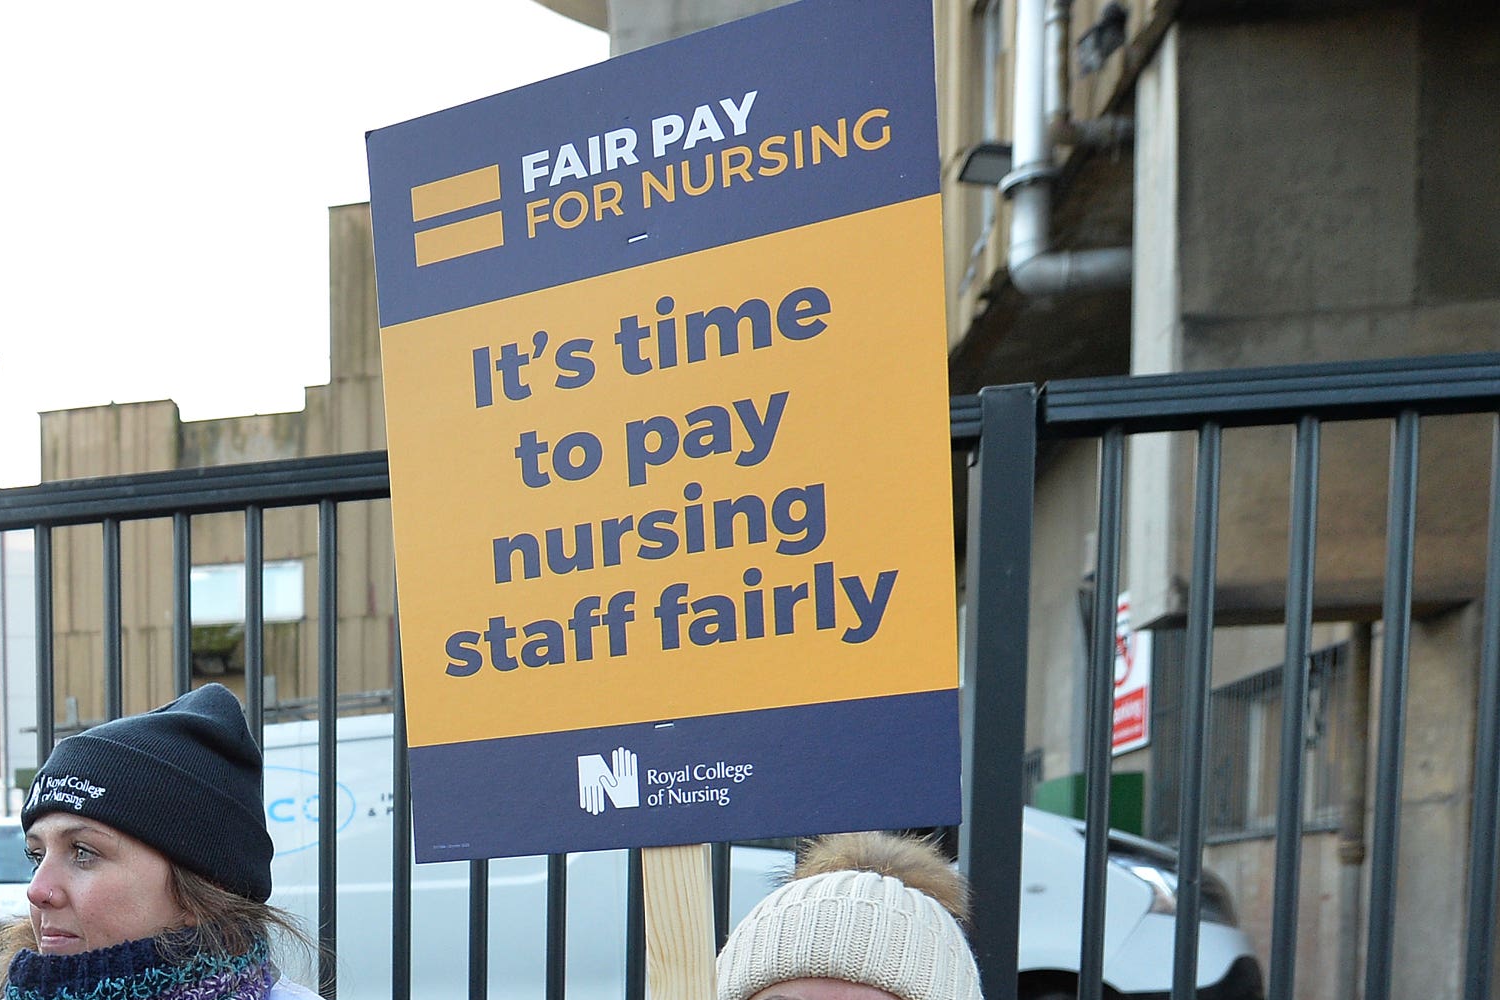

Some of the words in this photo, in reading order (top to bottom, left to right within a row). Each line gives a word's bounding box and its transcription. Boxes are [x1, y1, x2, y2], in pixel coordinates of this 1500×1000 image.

[521, 126, 640, 194] FAIR
[652, 90, 758, 159] PAY
[525, 181, 625, 239] FOR
[641, 107, 893, 209] NURSING
[471, 330, 597, 409] It's
[614, 285, 832, 376] time
[514, 429, 603, 489] to
[625, 390, 790, 487] pay
[492, 481, 827, 585] nursing
[444, 589, 636, 678] staff
[654, 561, 899, 651] fairly
[41, 790, 53, 802] of
[51, 790, 85, 810] Nursing
[46, 775, 69, 790] Royal
[68, 777, 106, 798] College
[647, 765, 690, 789] Royal
[693, 761, 753, 783] College
[647, 788, 665, 806] of
[668, 786, 730, 806] Nursing
